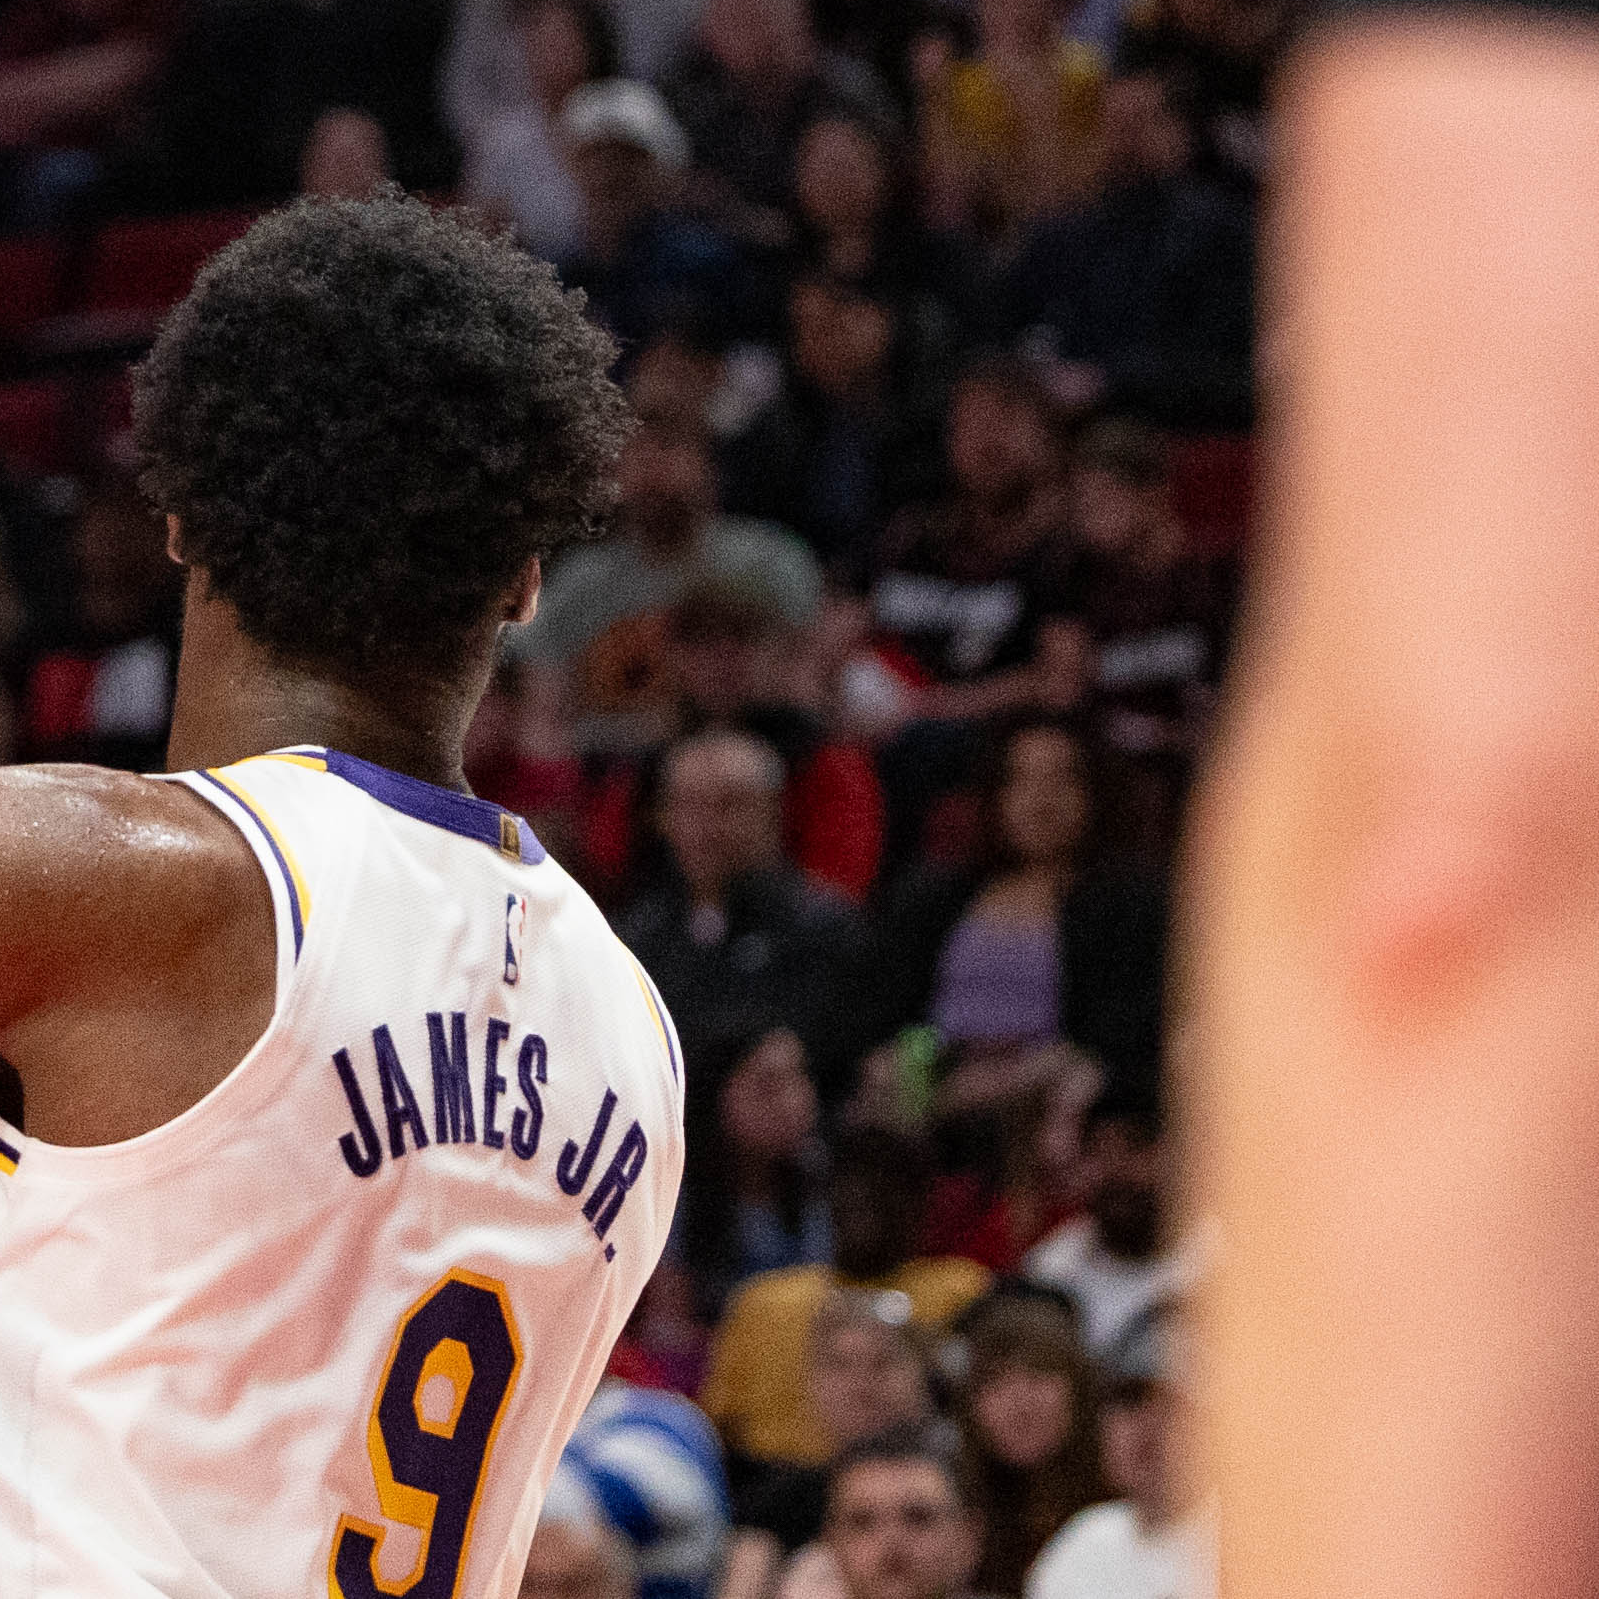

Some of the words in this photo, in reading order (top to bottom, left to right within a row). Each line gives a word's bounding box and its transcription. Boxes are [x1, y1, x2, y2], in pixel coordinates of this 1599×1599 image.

[332, 1010, 549, 1179] JAMES
[555, 1086, 650, 1264] JR.
[327, 1265, 525, 1599] 9
